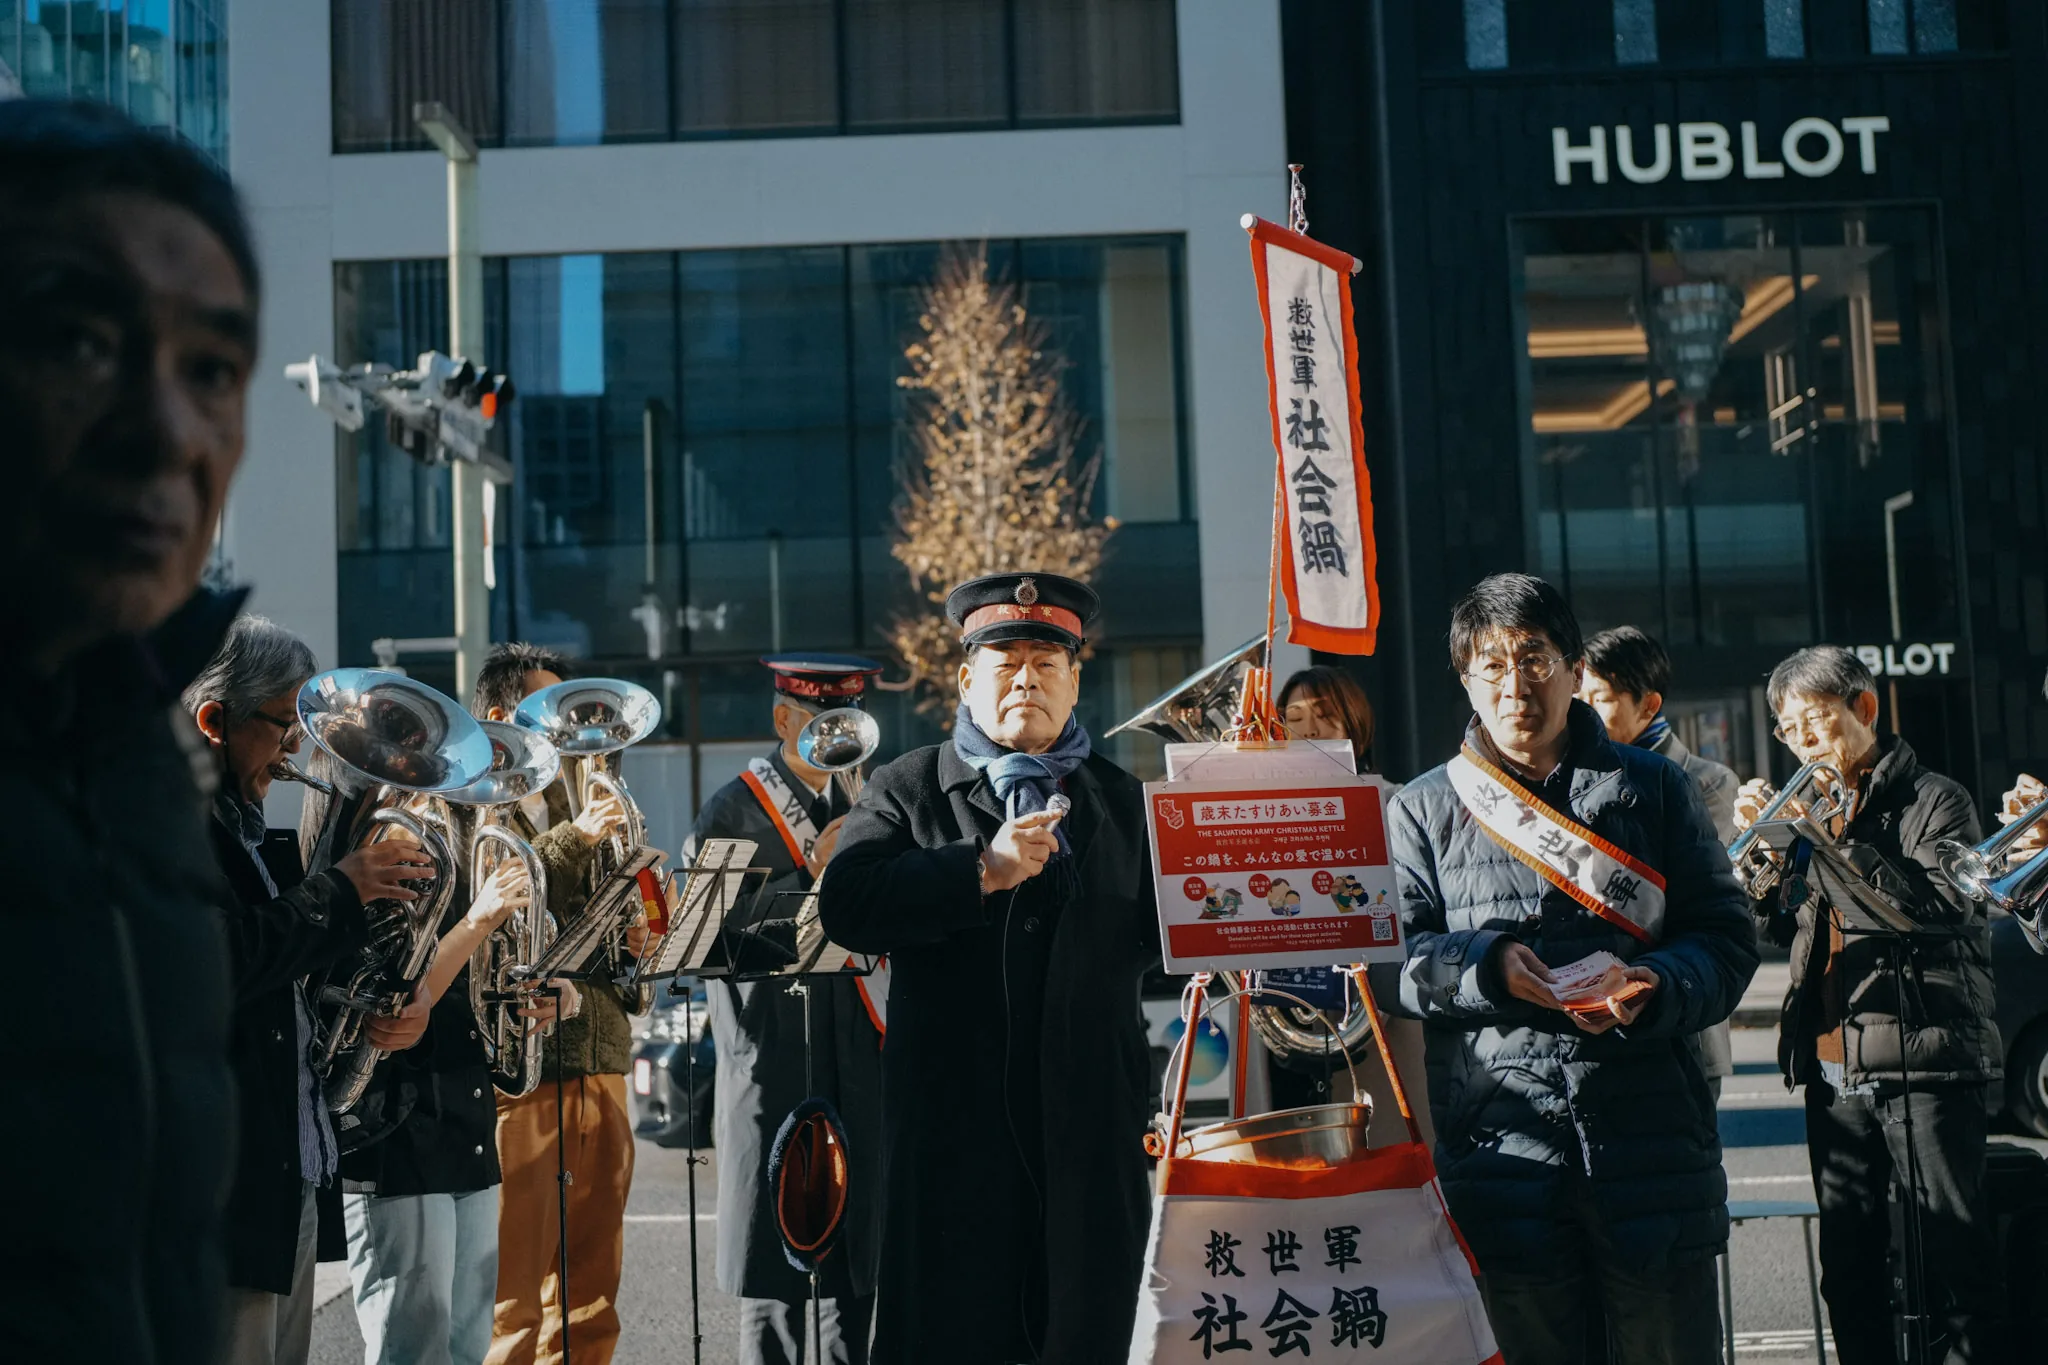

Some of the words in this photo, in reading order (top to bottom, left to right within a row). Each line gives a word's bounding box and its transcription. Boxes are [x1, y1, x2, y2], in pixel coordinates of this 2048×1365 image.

[1552, 116, 1890, 186] HUBLOT
[1846, 643, 1955, 676] BLOT
[1200, 801, 1338, 821] 歳末たすけあい募金
[1214, 828, 1253, 837] SALVATION
[1254, 827, 1274, 835] ARMY
[1276, 826, 1317, 834] CHRISTMAS
[1319, 824, 1345, 832] KETTLE
[1472, 782, 1642, 909] 救世軍
[1204, 1225, 1363, 1278] 救世軍
[1189, 1286, 1388, 1360] 社会鍋
